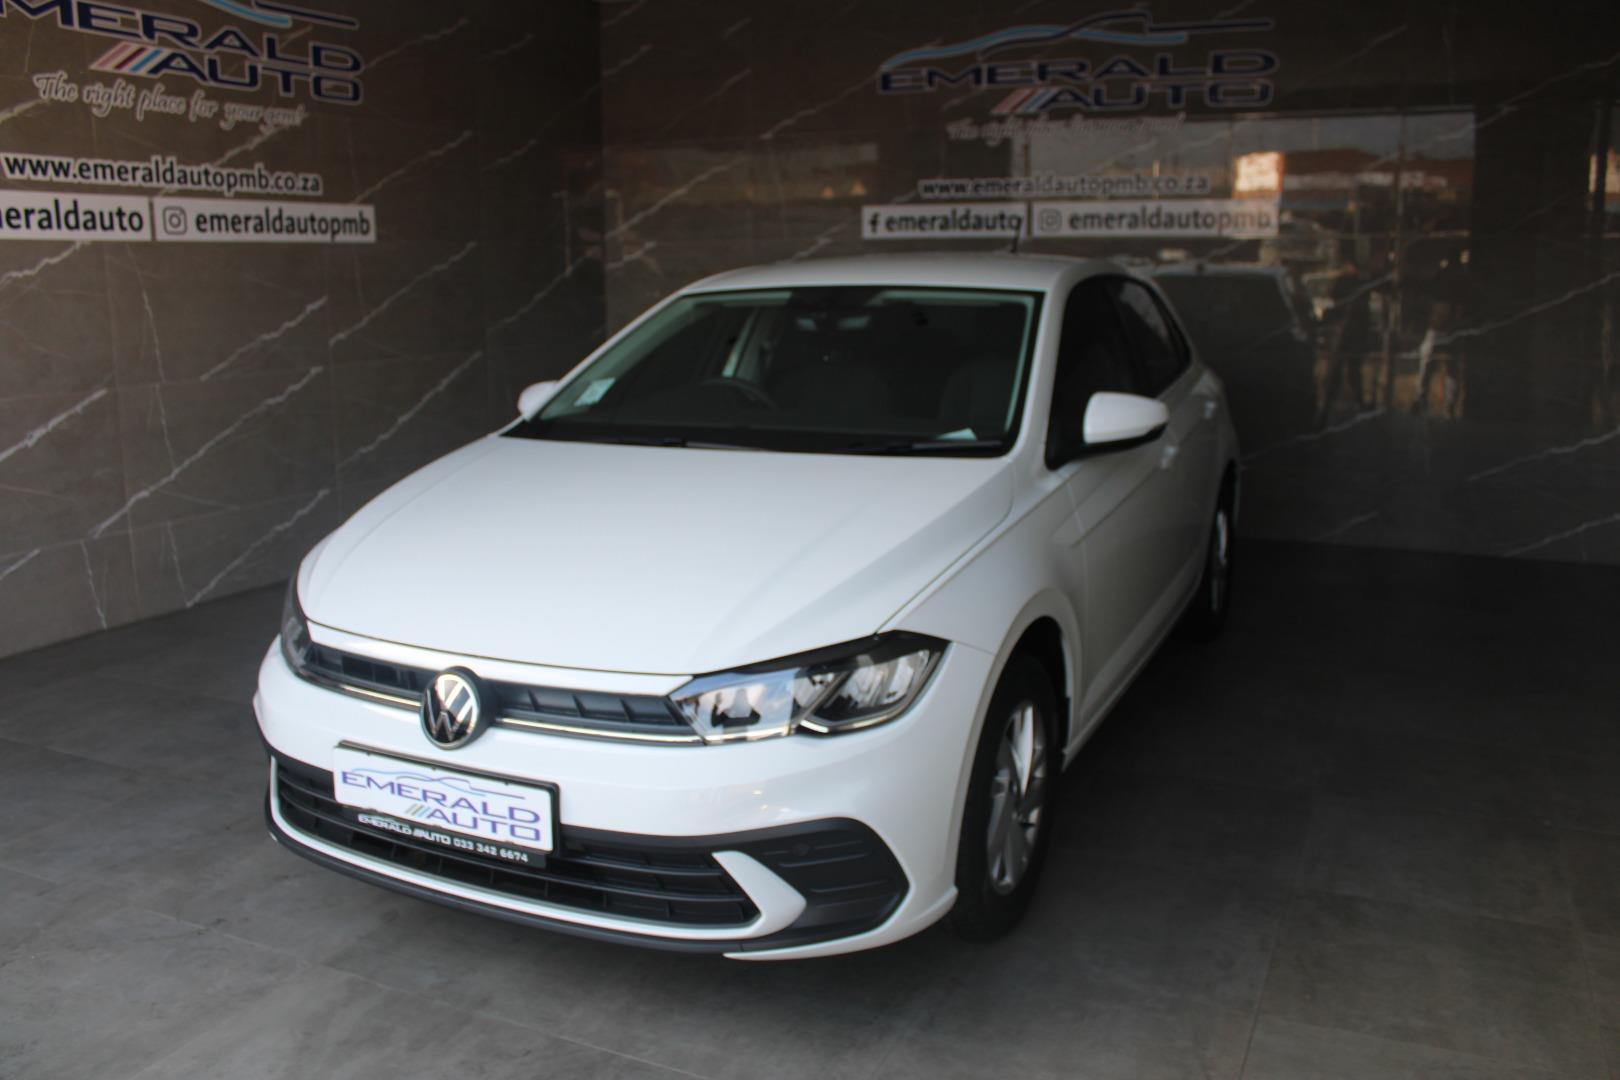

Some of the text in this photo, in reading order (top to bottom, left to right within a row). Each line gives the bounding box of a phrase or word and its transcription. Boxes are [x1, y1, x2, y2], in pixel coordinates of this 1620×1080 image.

[148, 52, 361, 102] AUTO
[880, 53, 1277, 91] EMERALD
[34, 71, 78, 101] The
[83, 77, 135, 117] right
[136, 84, 186, 121] place
[188, 89, 218, 122] for
[1040, 82, 1271, 108] AUTO
[5, 157, 320, 195] www.emeraldautopmb.co.za
[0, 199, 143, 232] eraldauto
[196, 208, 370, 236] emeraldautopmb
[885, 208, 1022, 232] emeraldauto
[1069, 206, 1270, 235] emeraldautopmb
[341, 771, 541, 824] EMERALD
[358, 814, 411, 835] EMERALD
[453, 838, 474, 851] 033
[476, 843, 498, 856] 342
[500, 848, 529, 864] 6674
[427, 808, 541, 842] AUTO
